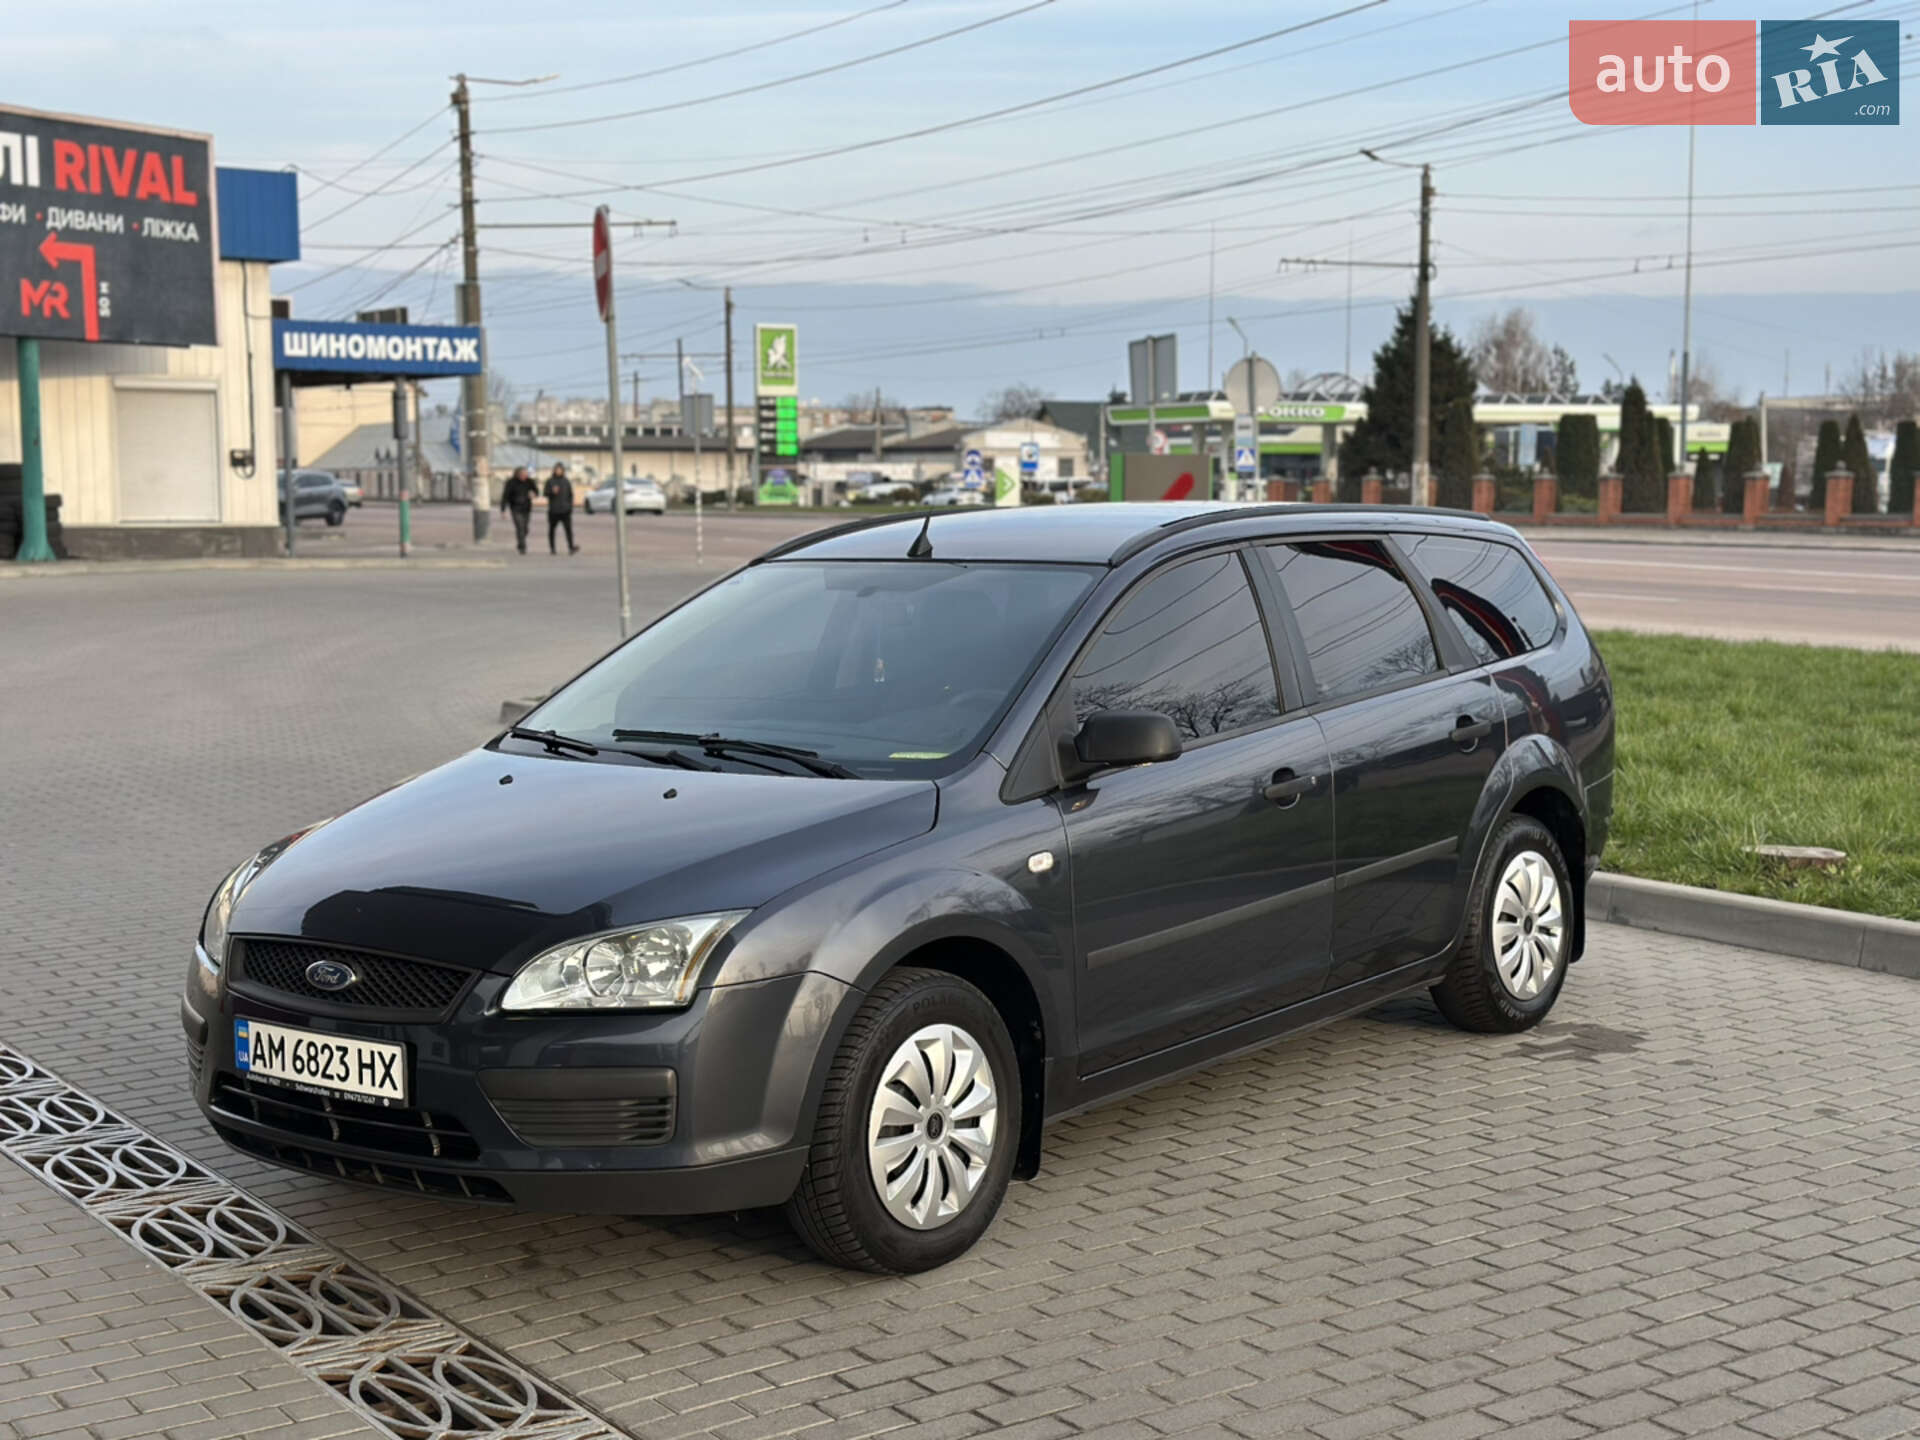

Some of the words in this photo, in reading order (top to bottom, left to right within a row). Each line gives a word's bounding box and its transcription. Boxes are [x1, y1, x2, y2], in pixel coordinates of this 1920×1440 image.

[53, 138, 198, 206] RIVAL
[46, 206, 124, 234] ДИВАНИ
[142, 217, 199, 243] ЛІЖКА
[283, 331, 479, 363] ШИНОМОНТАЖ
[1269, 406, 1325, 417] OKKO
[313, 966, 341, 985] Ford
[238, 1051, 249, 1062] UA
[252, 1031, 286, 1072] AM
[292, 1038, 350, 1083] 6823
[357, 1048, 398, 1092] HX
